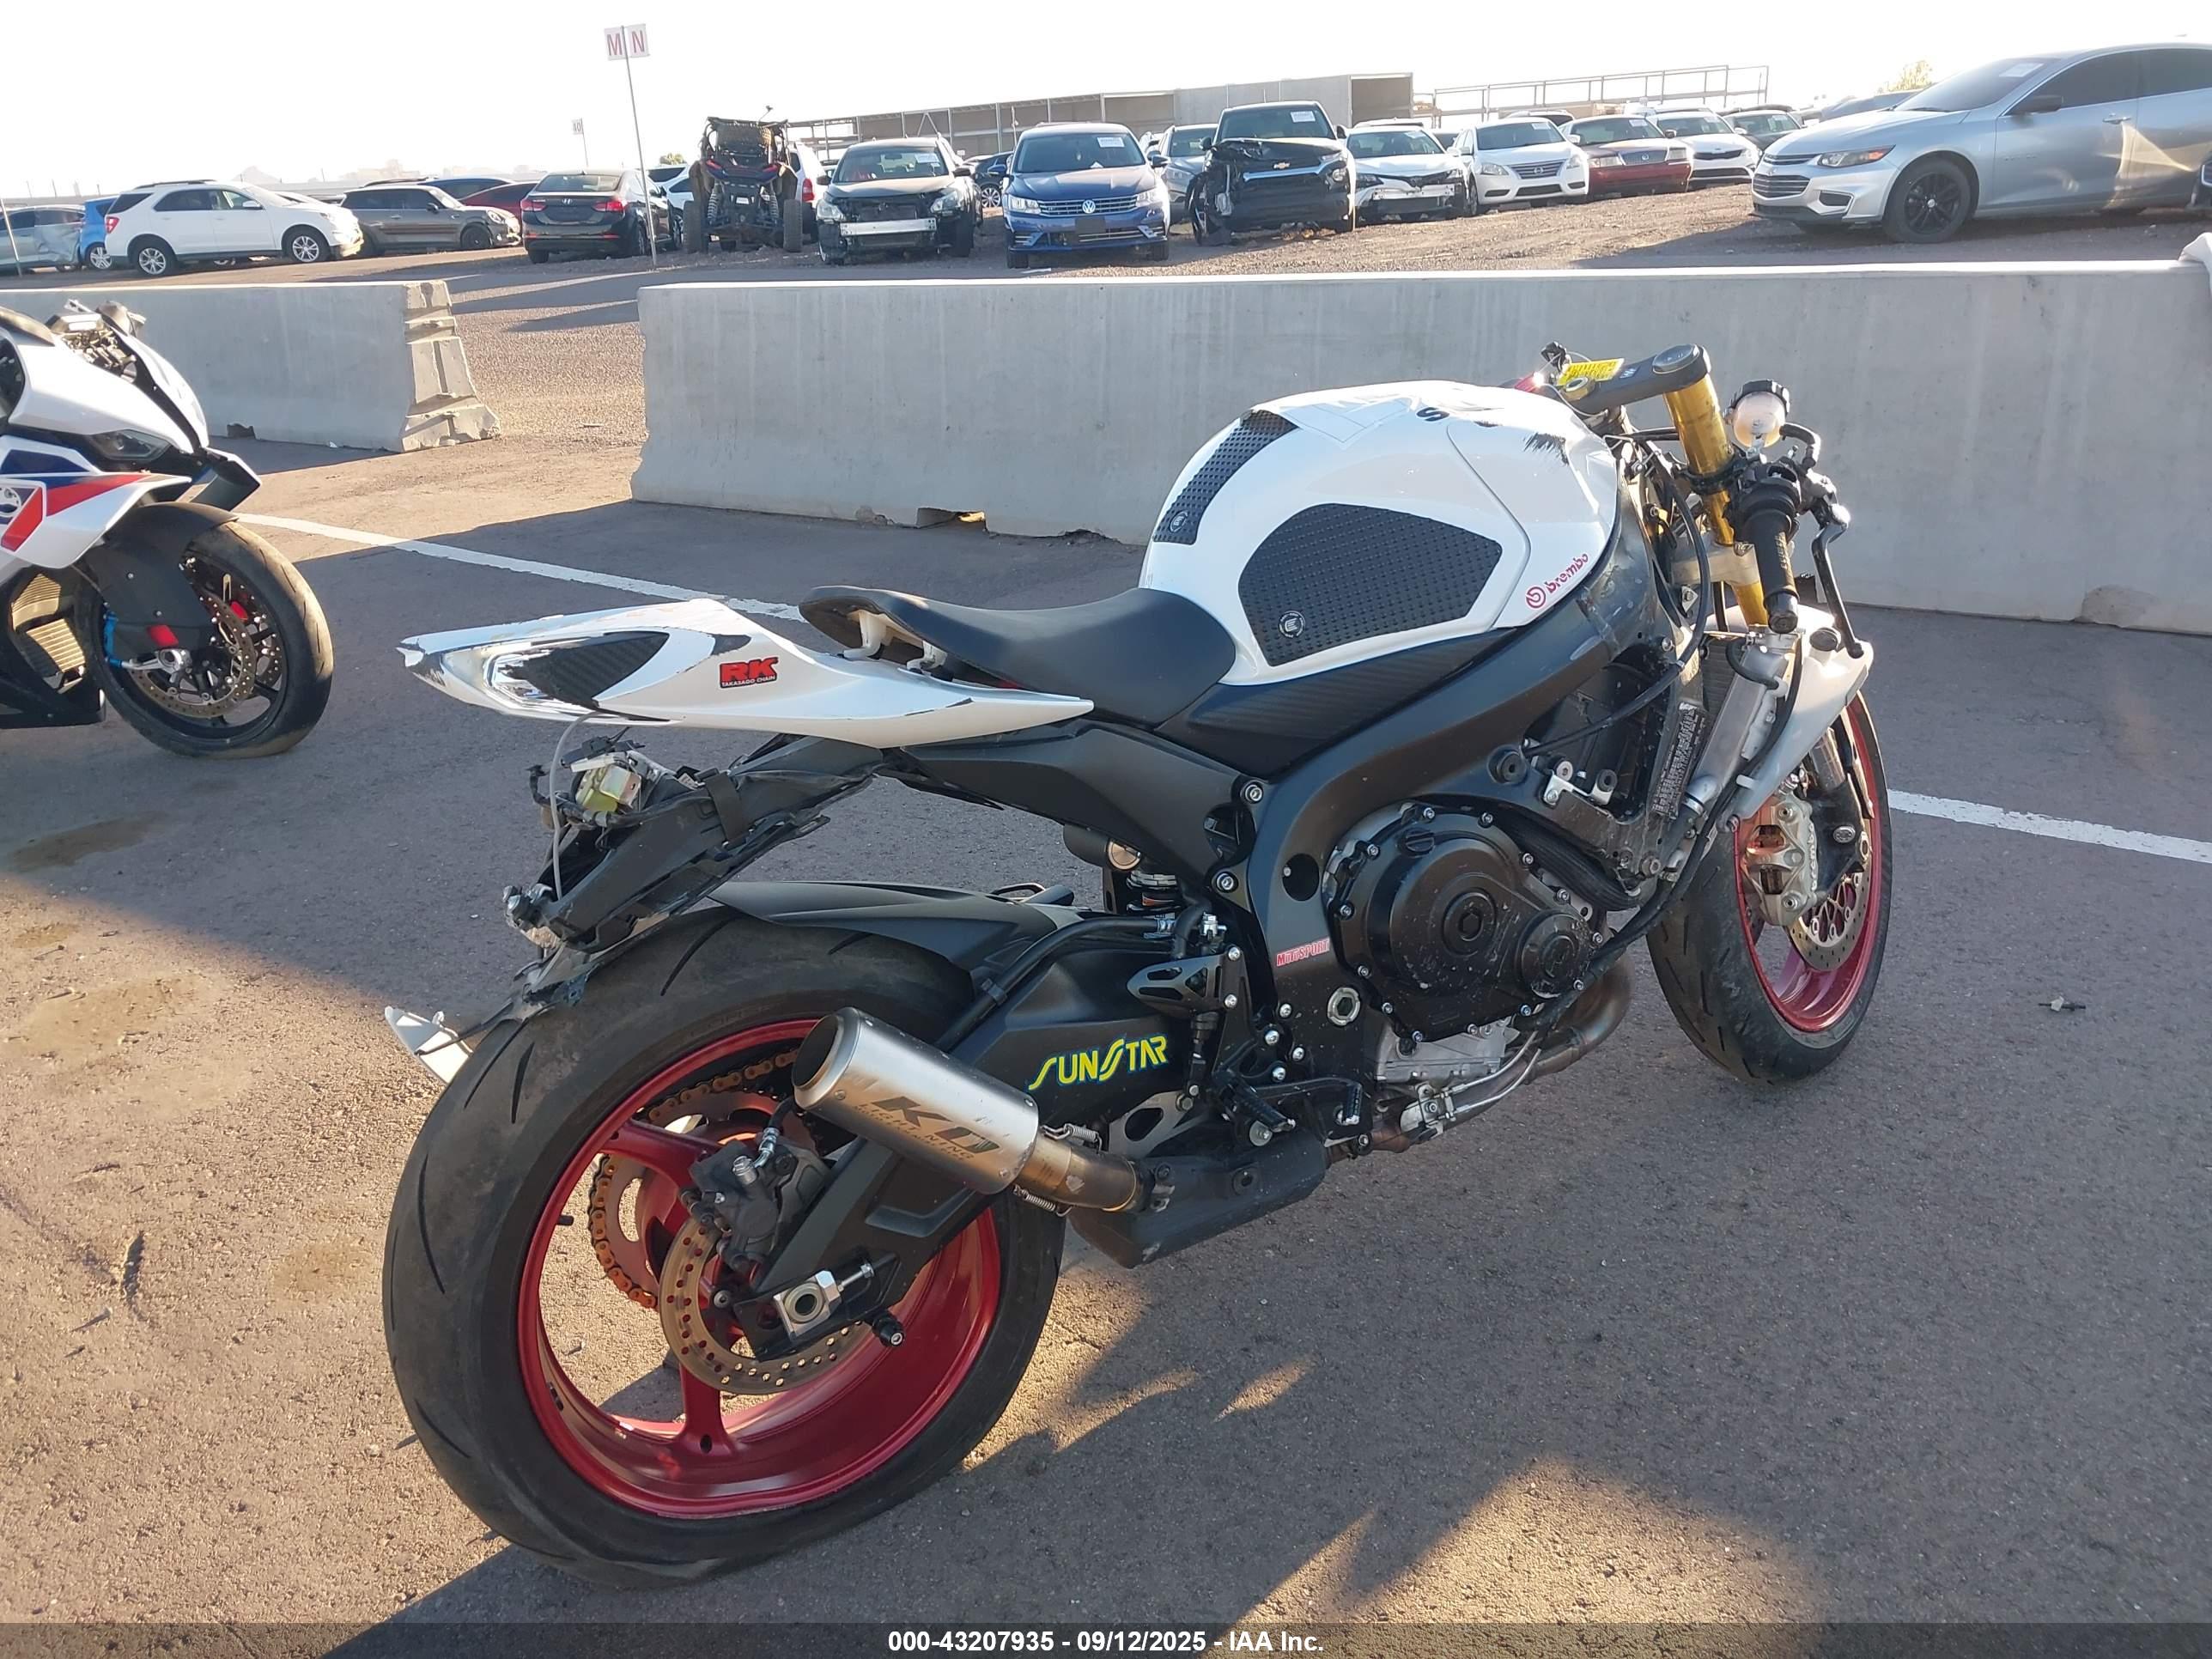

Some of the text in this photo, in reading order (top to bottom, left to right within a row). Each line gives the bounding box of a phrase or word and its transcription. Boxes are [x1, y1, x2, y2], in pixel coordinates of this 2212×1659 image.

[606, 29, 645, 56] M N
[1544, 553, 1589, 593] brembo
[720, 657, 778, 682] RK
[1807, 823, 1818, 892] brembo
[1028, 1036, 1167, 1091] SUNSTAR
